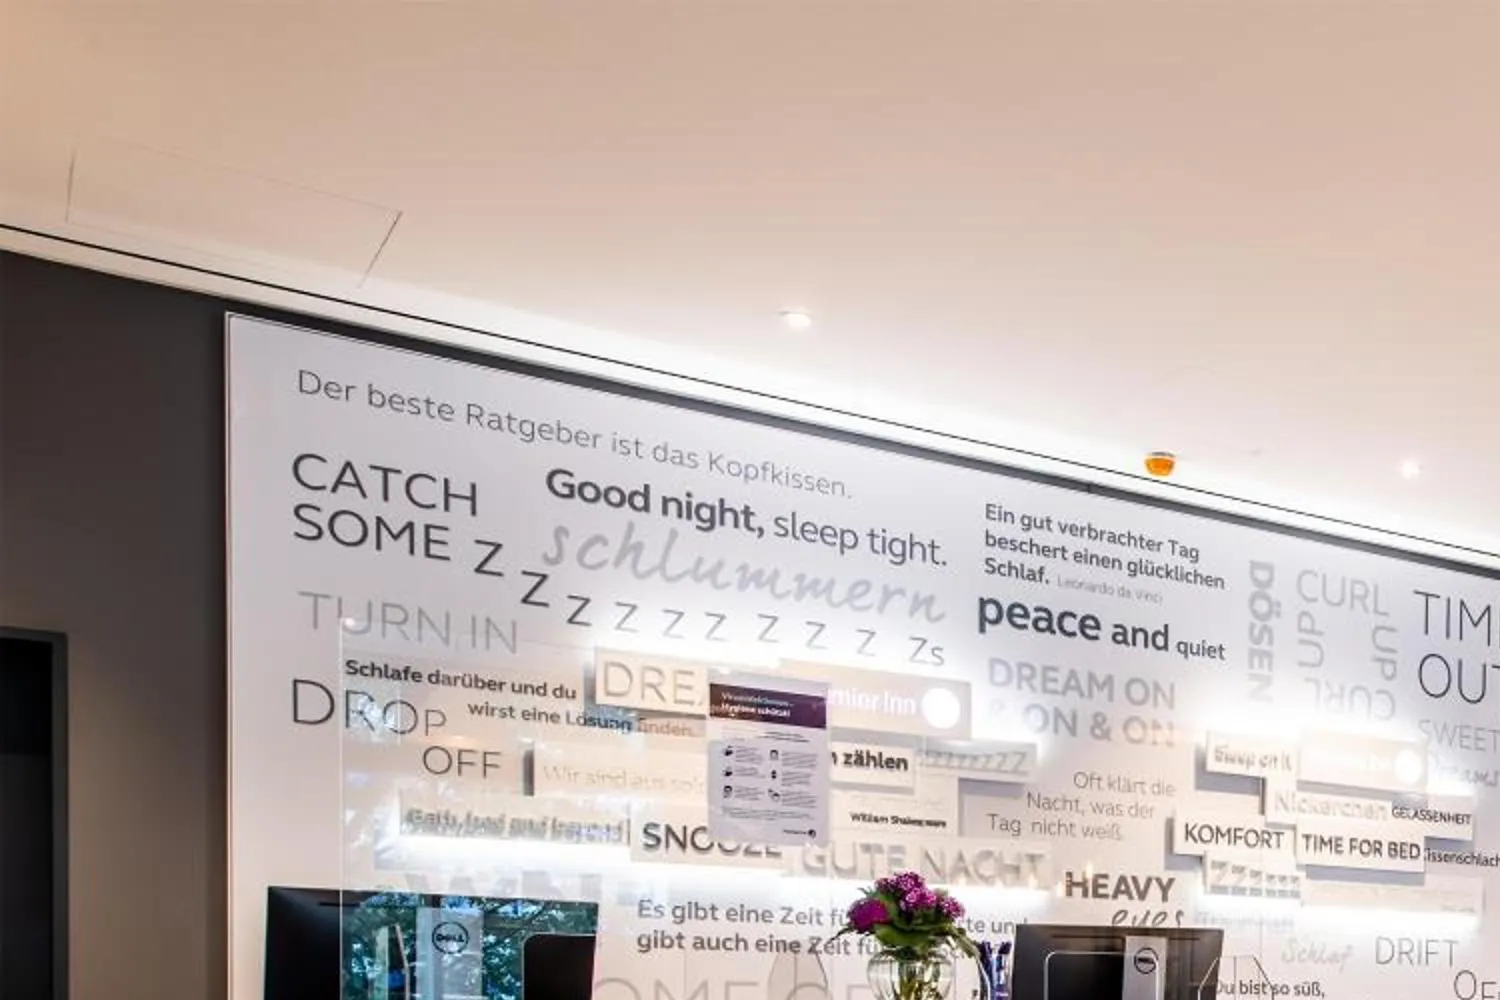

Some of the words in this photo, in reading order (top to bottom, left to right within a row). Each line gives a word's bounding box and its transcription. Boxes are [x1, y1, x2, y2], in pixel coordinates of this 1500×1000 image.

[298, 369, 357, 401] Der
[367, 383, 455, 422] beste
[466, 403, 602, 449] Ratgeber
[611, 432, 644, 459] ist
[652, 441, 699, 469] das
[708, 451, 853, 500] Kopfkissen.
[292, 453, 477, 517] CATCH
[546, 468, 651, 513] Good
[661, 491, 765, 539] night,
[774, 511, 859, 556] sleep
[867, 527, 948, 567] tight.
[985, 503, 1015, 524] Ein
[1020, 511, 1053, 532] gut
[1057, 521, 1163, 552] verbrachter
[1168, 539, 1200, 563] Tag
[543, 519, 947, 624] schlummern
[984, 557, 1050, 585] Schlaf.
[1057, 575, 1115, 597] Leonardo
[985, 530, 1068, 561] beschert
[1073, 548, 1123, 572] einen
[1127, 558, 1225, 590] glücklichen
[293, 503, 451, 561] SOME
[907, 636, 945, 667] Zs
[1296, 569, 1390, 618] CURL
[298, 590, 450, 647] TURN
[470, 614, 518, 655] IN
[977, 596, 1102, 641] peace
[1111, 624, 1169, 652] and
[1176, 640, 1226, 661] quiet
[1247, 560, 1282, 704] DÖSEN
[1297, 610, 1325, 668] UP
[1370, 625, 1398, 682] UP
[345, 659, 423, 683] Schlafe
[426, 668, 506, 694] darüber
[511, 679, 548, 698] und
[551, 684, 577, 701] du
[603, 660, 705, 706] DRE
[827, 688, 883, 711] mier
[989, 657, 1115, 703] DREAM
[1124, 677, 1176, 711] ON
[291, 678, 448, 737] DROP
[467, 702, 517, 721] wirst
[521, 706, 560, 724] eine
[565, 711, 633, 735] Lösung
[1023, 703, 1077, 738] ON
[1089, 711, 1112, 742] &
[1122, 716, 1176, 749] ON
[422, 745, 503, 779] OFF
[843, 749, 909, 771] zählen
[1027, 791, 1086, 816] Nacht,
[1089, 800, 1124, 817] was
[1127, 801, 1156, 819] der
[1072, 771, 1102, 791] Oft
[1107, 774, 1147, 795] klärt
[1151, 778, 1176, 797] die
[642, 822, 783, 858] SNO
[986, 813, 1022, 837] Tag
[1031, 817, 1076, 838] nicht
[1184, 823, 1285, 849] KOMFORT
[1302, 833, 1343, 855] TIME
[1349, 838, 1383, 859] FOR
[1388, 841, 1421, 861] BED
[803, 840, 907, 877] GUTE
[921, 848, 1044, 884] NACHT
[1065, 871, 1176, 903] HEAVY
[638, 899, 664, 919] Es
[671, 901, 718, 924] gibt
[726, 905, 773, 924] eine
[780, 907, 823, 926] Zeit
[991, 917, 1028, 934] un
[637, 930, 686, 954] gibt
[692, 932, 749, 953] auch
[755, 934, 802, 953] eine
[808, 937, 850, 956] Zeit
[1375, 936, 1459, 968] DRIFT
[1240, 979, 1268, 995] bist
[1271, 983, 1290, 995] so
[1293, 979, 1325, 999] süß,
